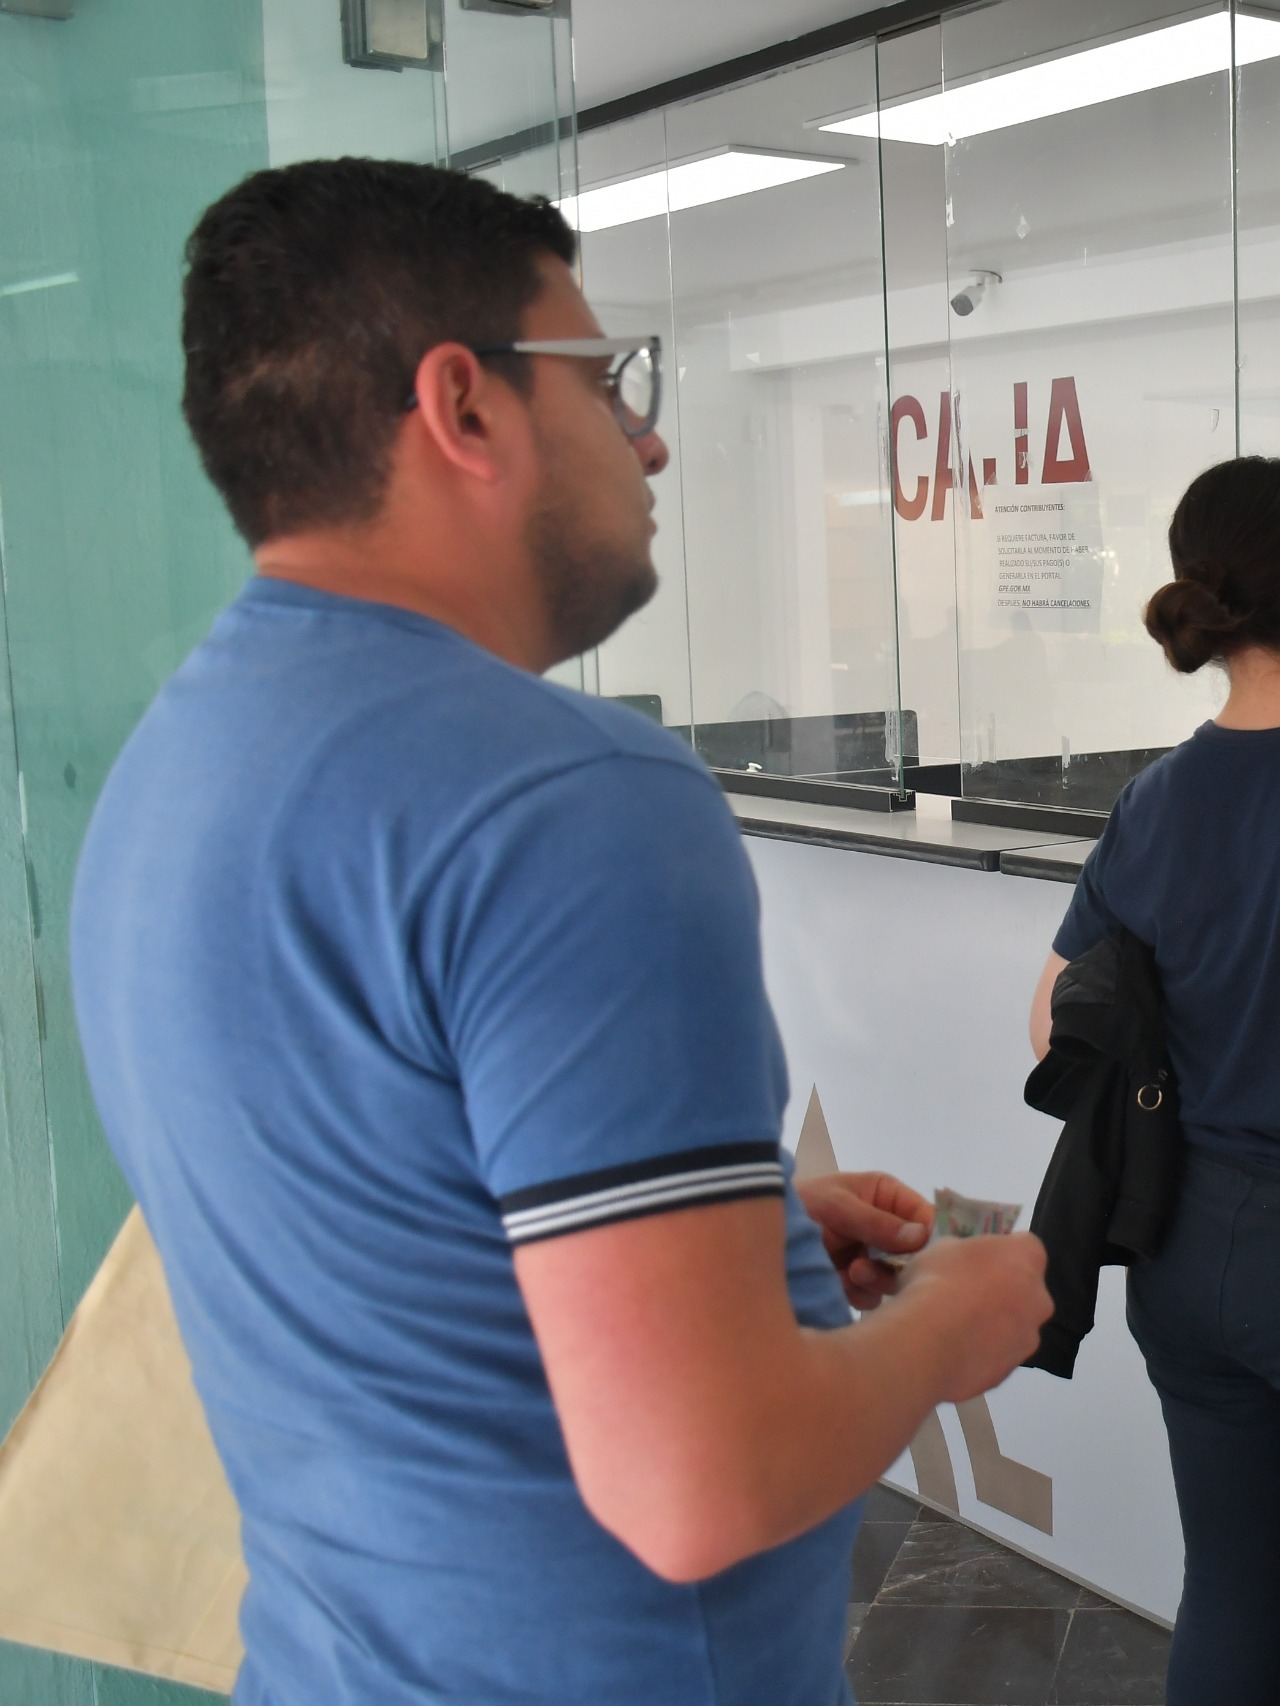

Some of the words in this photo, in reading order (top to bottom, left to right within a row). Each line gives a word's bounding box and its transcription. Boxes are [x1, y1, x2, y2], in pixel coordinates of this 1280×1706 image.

[994, 504, 1019, 513] ATENCIÓN
[1019, 503, 1066, 512] CONTRIBUYENTES:
[1001, 534, 1024, 542] REQUIERE
[1025, 534, 1048, 542] FACTURA,
[1049, 533, 1067, 541] FAVOR
[1068, 532, 1076, 540] DE
[1033, 546, 1061, 554] MOMENTO
[999, 559, 1025, 567] REALIZADO
[1043, 559, 1065, 568] PAGO(S)
[1065, 559, 1071, 567] O
[999, 572, 1026, 580] GENERARLA
[1041, 572, 1062, 580] PORTAL
[1021, 599, 1031, 607] NO
[1032, 598, 1050, 607] HABRÁ
[1050, 599, 1092, 608] CANCELACIONES.
